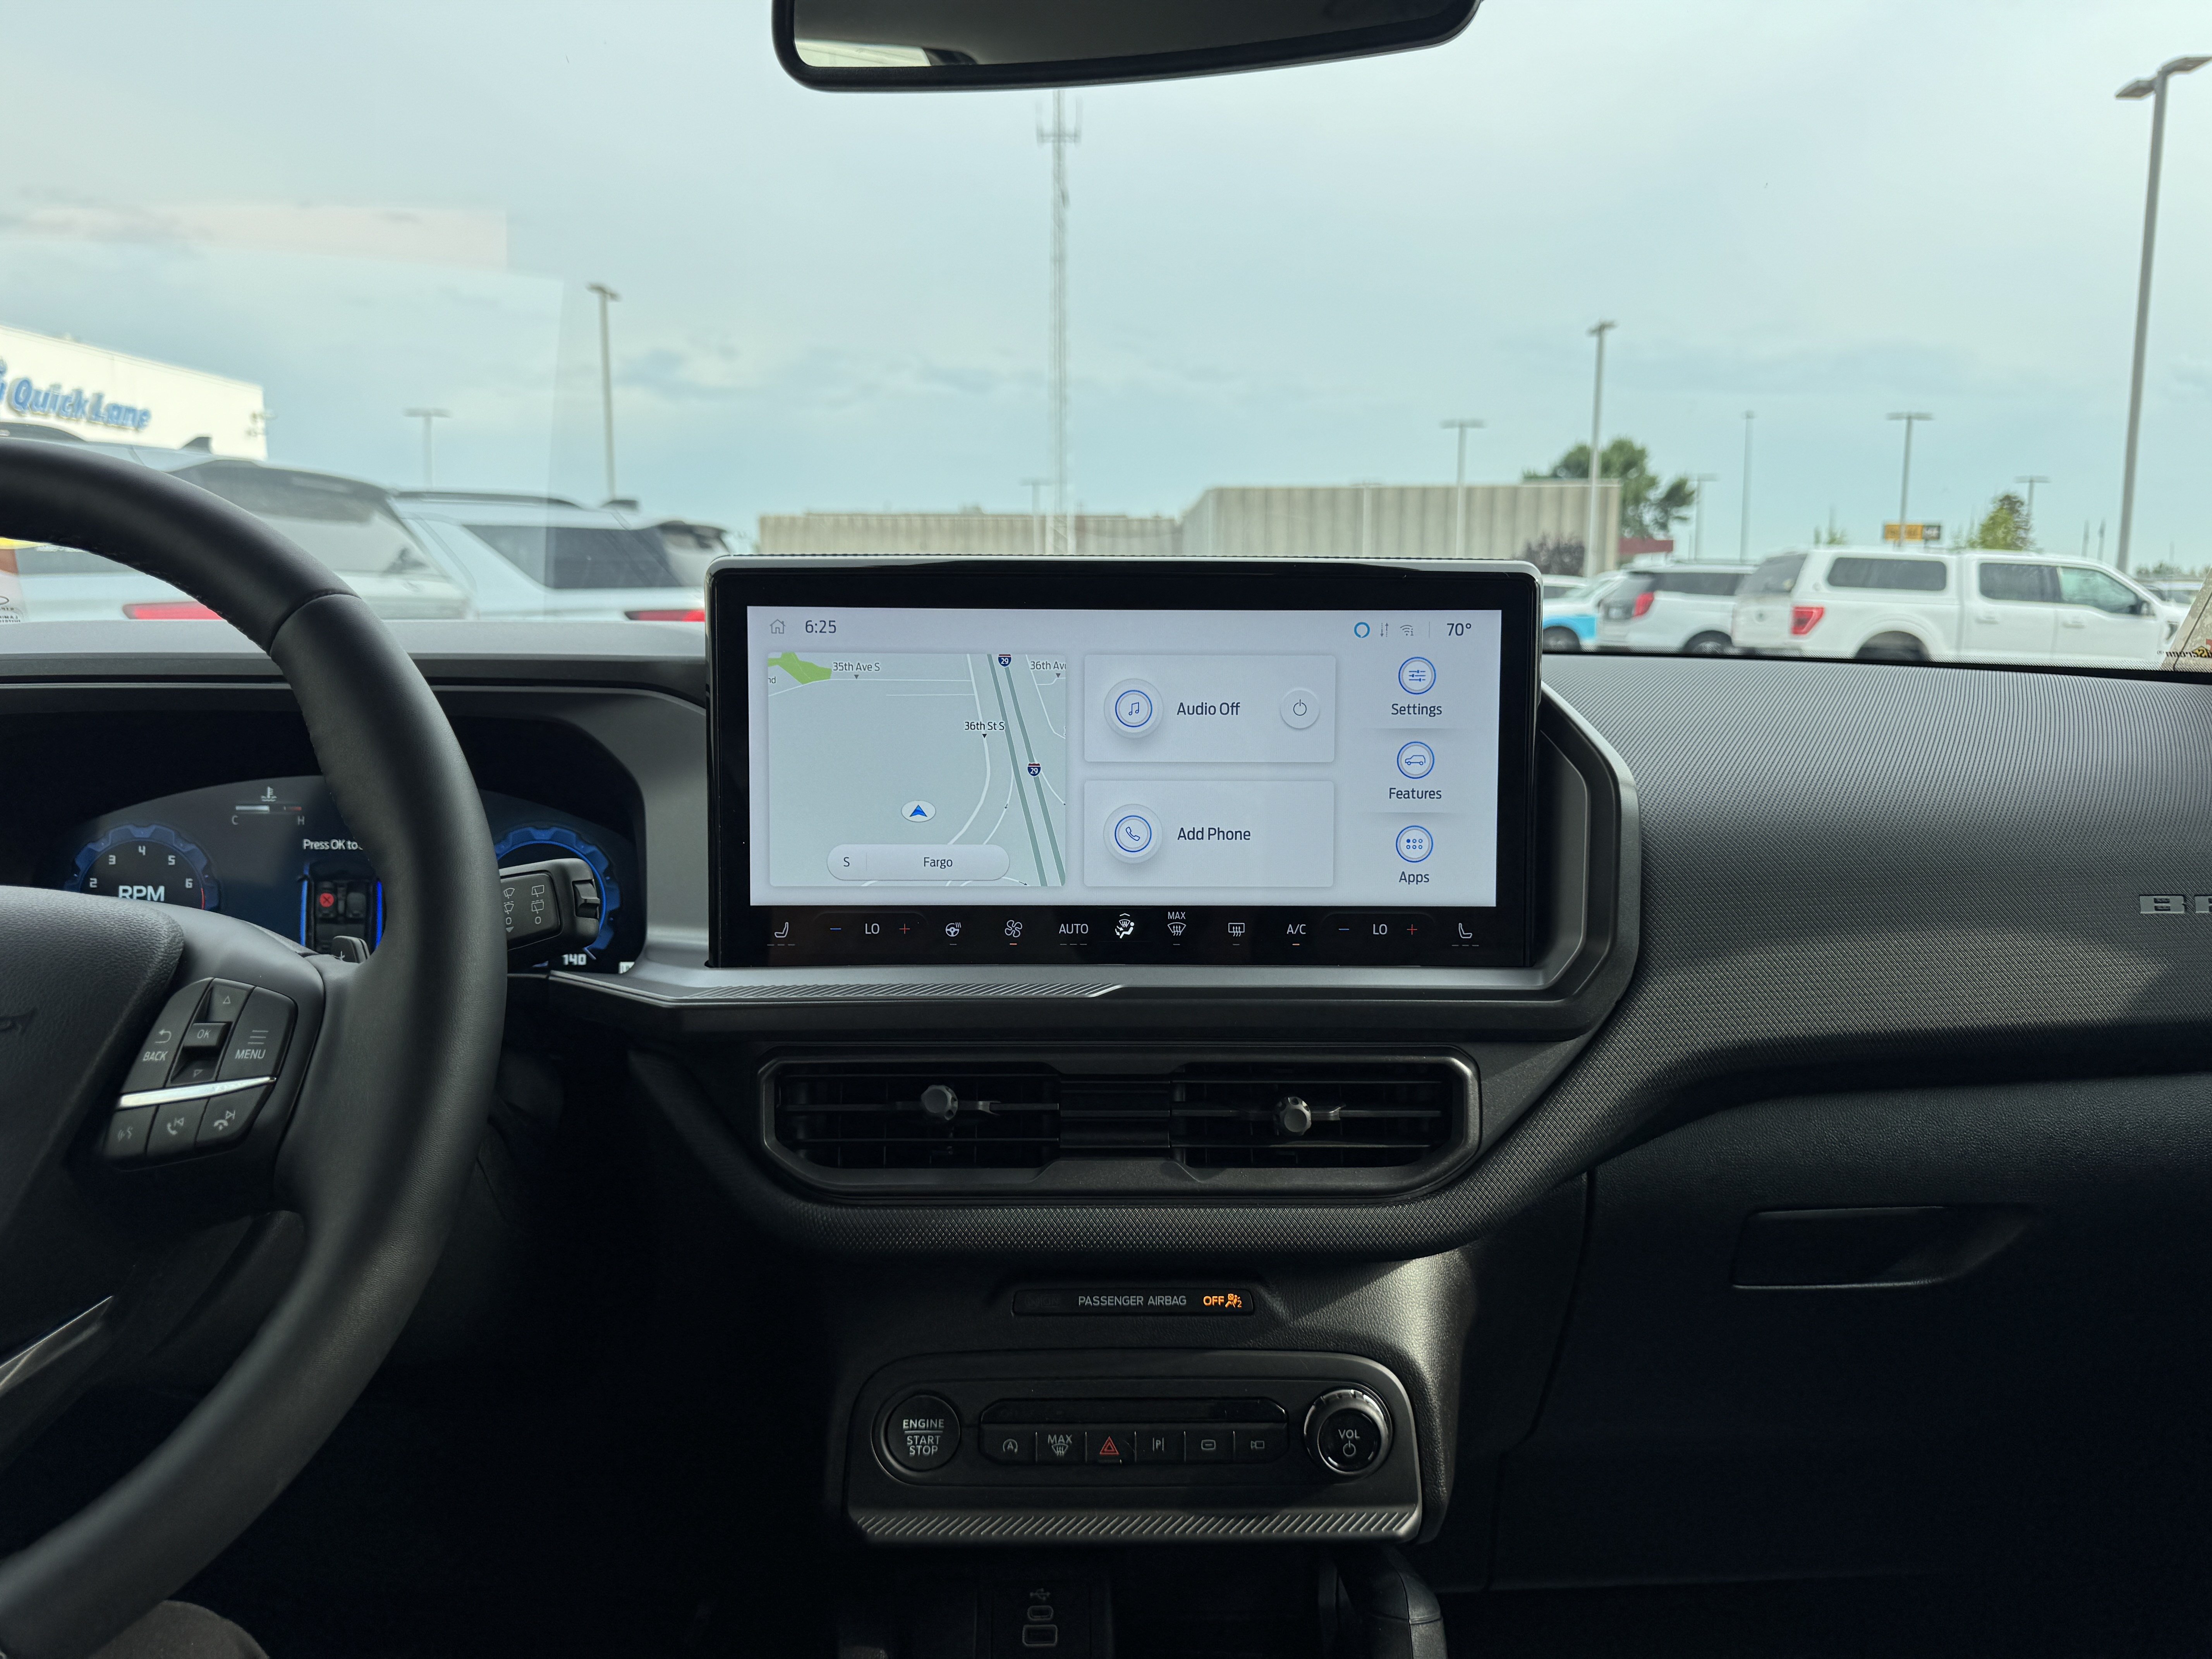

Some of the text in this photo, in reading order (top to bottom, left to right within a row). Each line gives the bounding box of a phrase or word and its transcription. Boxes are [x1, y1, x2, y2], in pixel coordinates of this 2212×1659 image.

[805, 620, 836, 634] 6:25
[833, 662, 880, 671] 35th Ave S
[1030, 661, 1051, 670] 36th
[1176, 702, 1240, 715] Audio Off
[1391, 703, 1442, 717] Settings
[965, 721, 1005, 730] 36th St S
[1389, 787, 1442, 799] Features
[297, 816, 304, 824] H
[1177, 827, 1251, 840] Add Phone
[303, 838, 358, 850] Press OK to
[138, 845, 146, 855] 4
[109, 855, 175, 865] 3 5
[843, 857, 953, 869] S Fargo
[89, 878, 193, 888] 2 6
[1399, 871, 1429, 885] Apps
[118, 885, 165, 902] RPM
[1168, 911, 1186, 919] MAX
[865, 923, 880, 934] LO
[1059, 924, 1089, 934] AUTO
[1286, 924, 1306, 934] A/C
[1373, 924, 1388, 935] LO
[563, 954, 586, 965] 140
[197, 1029, 211, 1039] OK
[143, 1051, 168, 1061] BACK
[235, 1049, 266, 1059] MENU
[1079, 1295, 1187, 1306] PASSENGER AIRBAG
[1203, 1296, 1224, 1305] OFF
[903, 1419, 944, 1429] ENGINE
[1338, 1429, 1360, 1439] VOL
[907, 1435, 940, 1445] START
[1048, 1434, 1072, 1445] MAX
[909, 1445, 938, 1455] STOP
